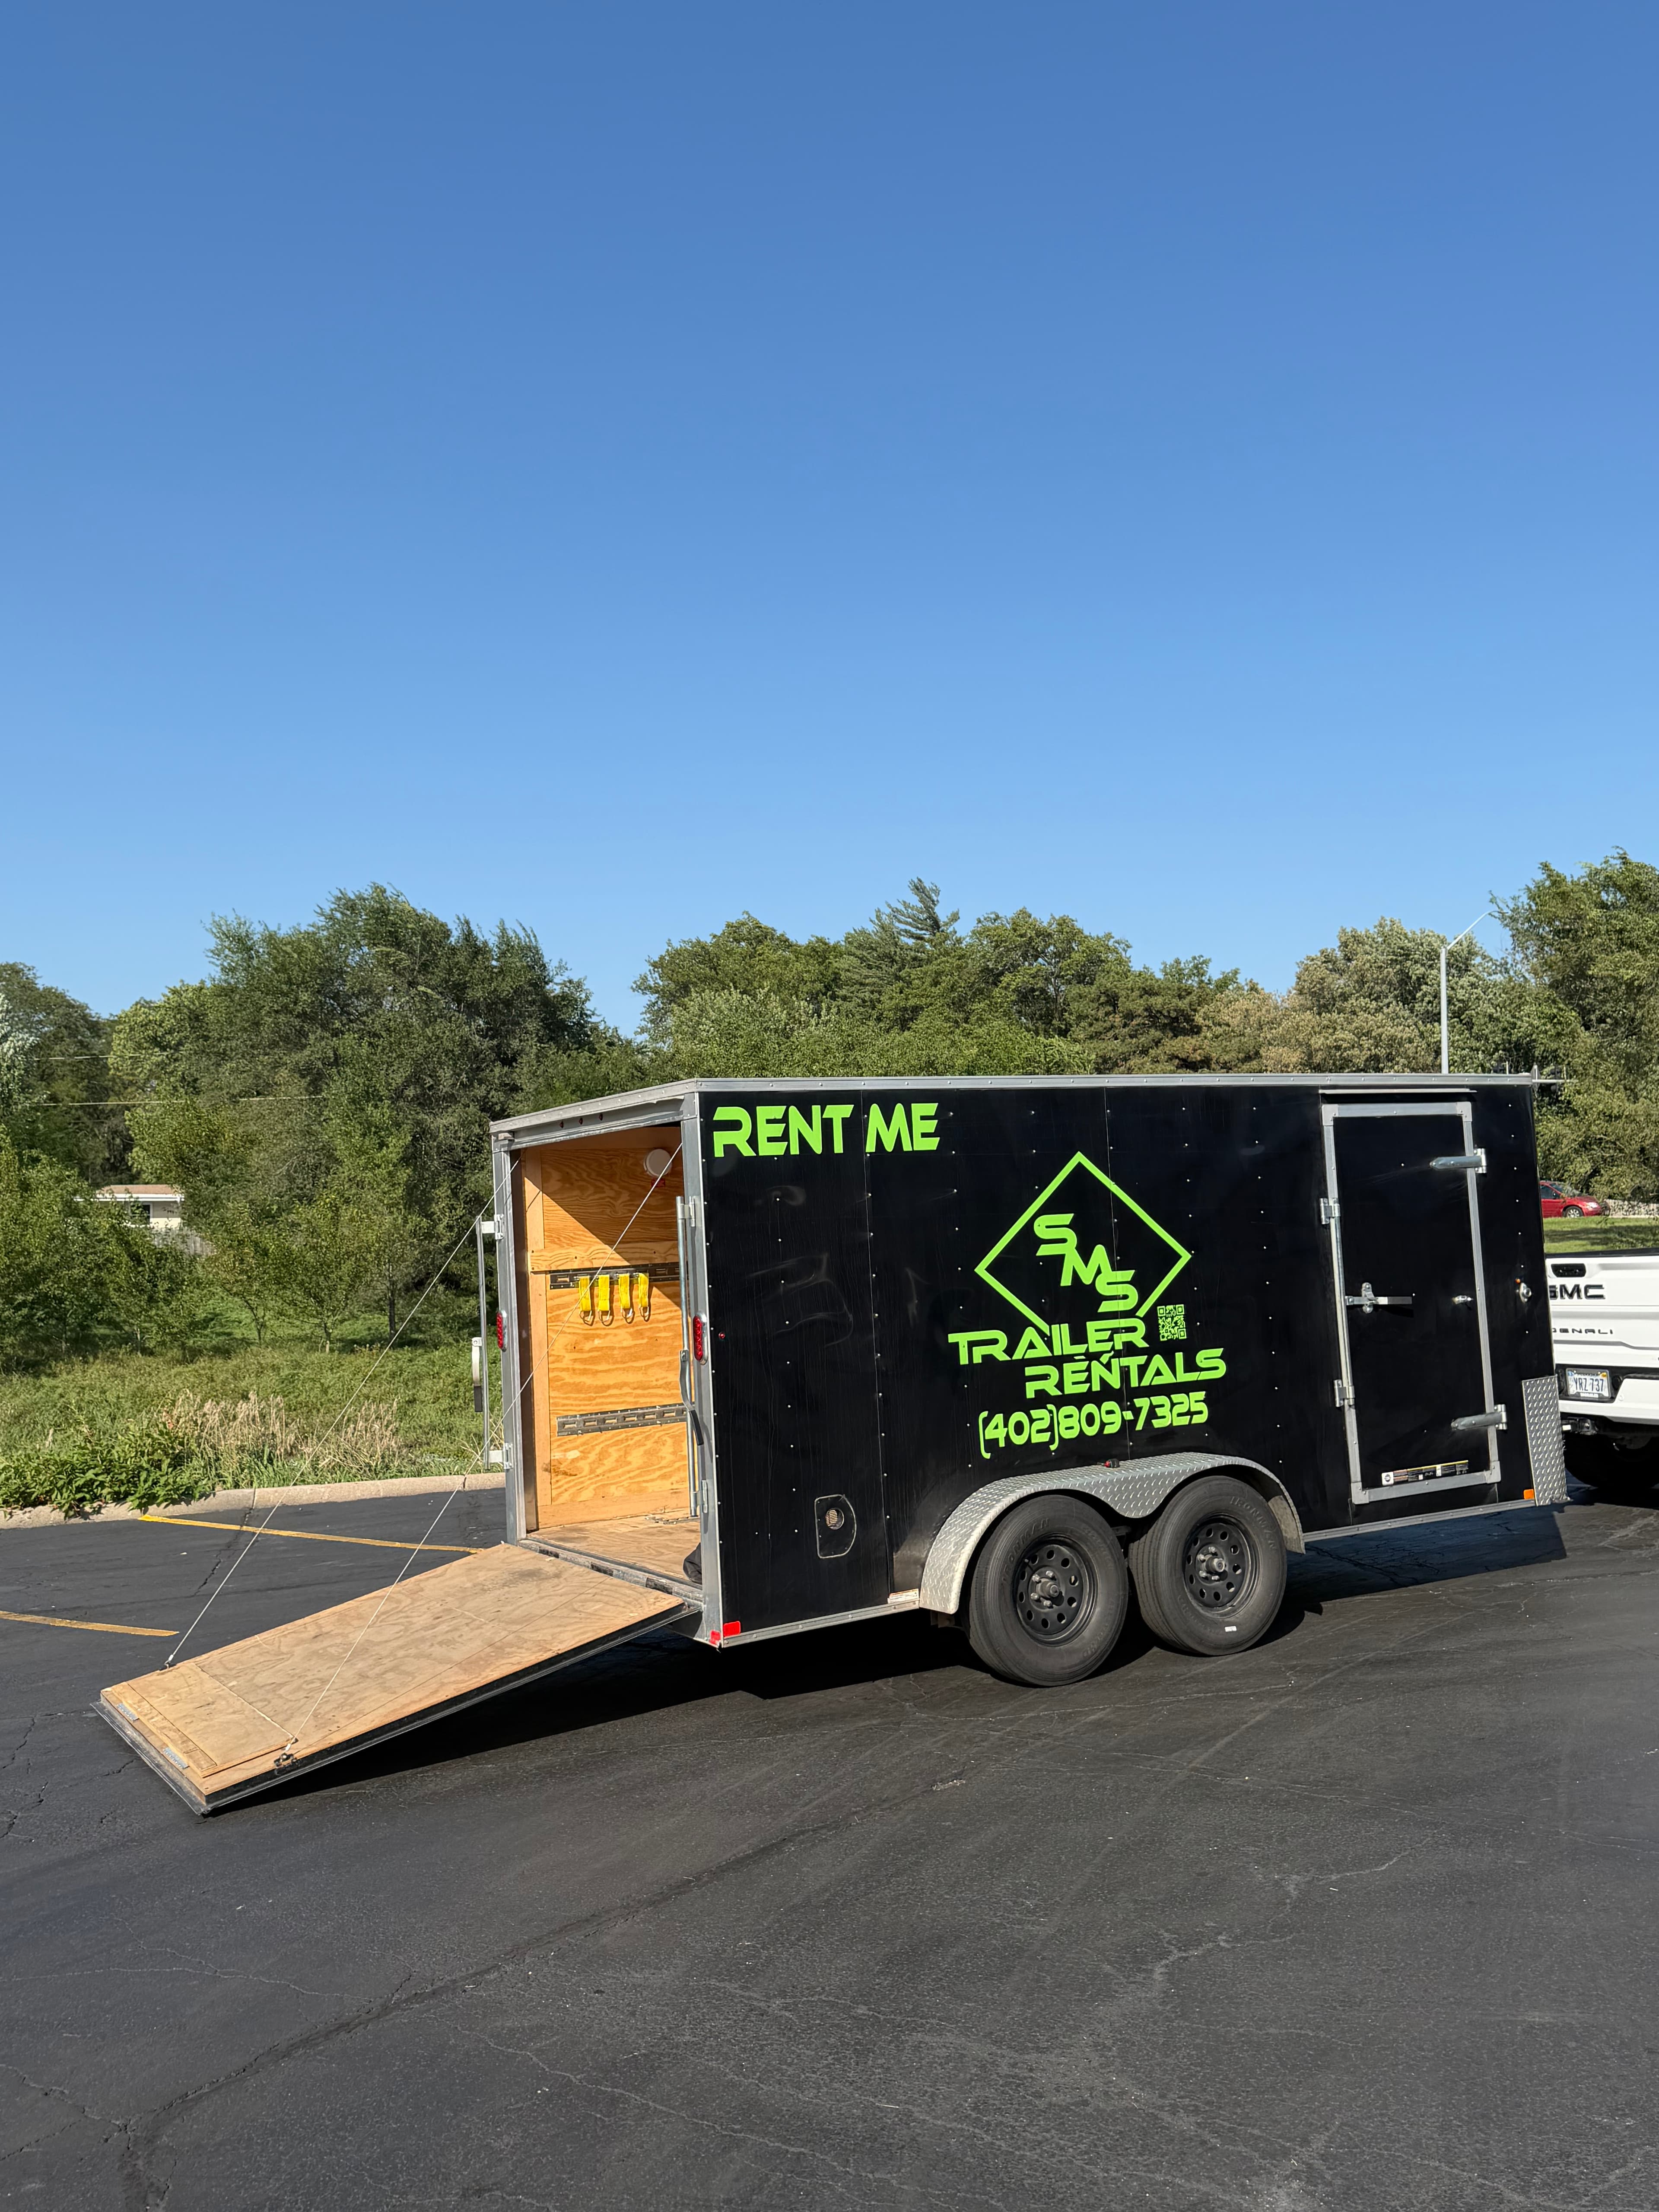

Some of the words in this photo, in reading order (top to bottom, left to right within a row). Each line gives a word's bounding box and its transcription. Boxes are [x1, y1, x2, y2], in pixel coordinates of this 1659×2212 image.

[713, 1104, 854, 1157] RENT
[865, 1103, 940, 1153] ME
[1033, 1213, 1138, 1313] SMS
[948, 1318, 1149, 1365] TRAILER
[1025, 1347, 1227, 1399] RENTALS
[1573, 1377, 1588, 1391] YRZ
[1590, 1378, 1604, 1392] 737
[978, 1391, 1208, 1459] (402)809-7325
